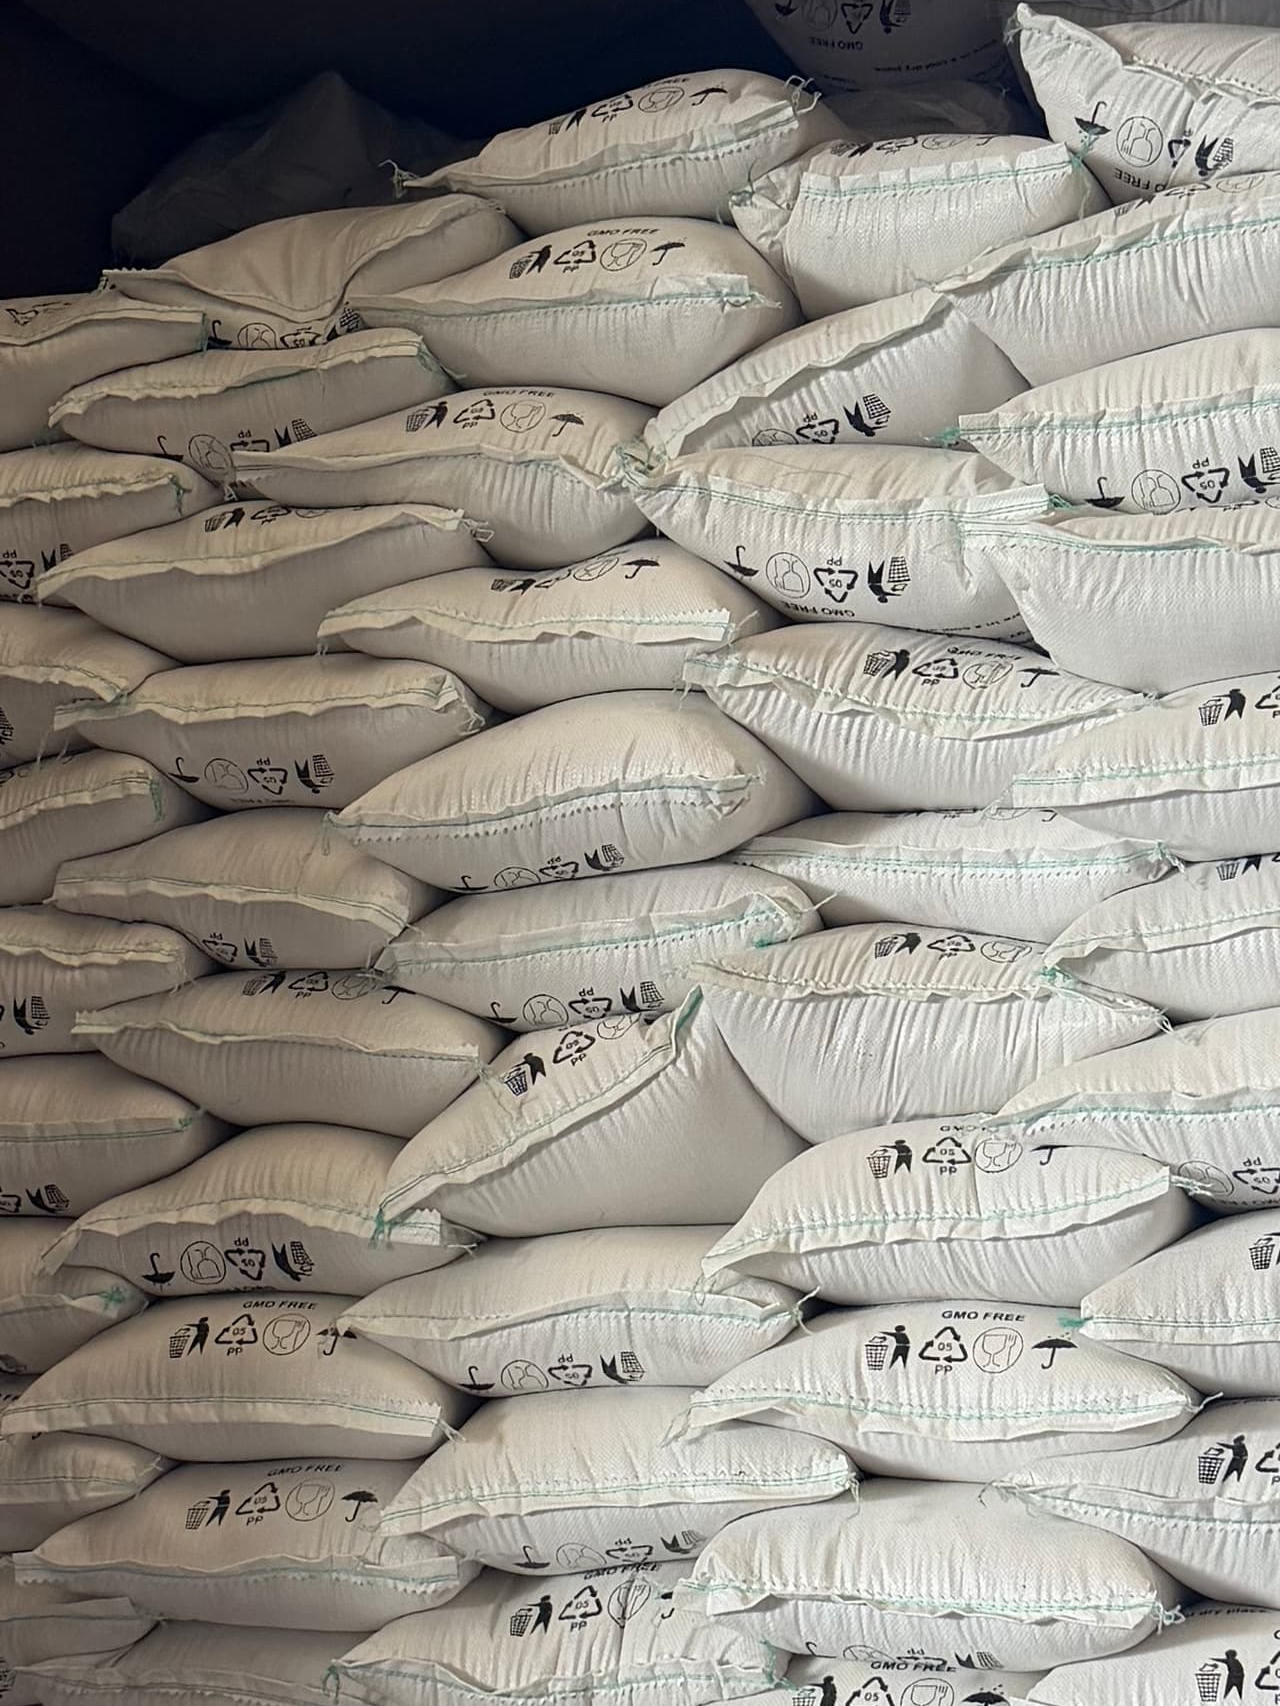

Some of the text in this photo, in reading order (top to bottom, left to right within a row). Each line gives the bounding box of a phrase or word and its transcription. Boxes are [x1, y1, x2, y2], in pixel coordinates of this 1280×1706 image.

[1113, 167, 1151, 190] FREE
[238, 430, 252, 438] PP
[813, 429, 828, 438] 05
[1192, 458, 1209, 468] PP
[2, 550, 17, 558] PP
[827, 558, 842, 566] PP
[10, 570, 24, 578] 05
[829, 579, 842, 588] 05
[256, 757, 271, 766] PP
[295, 990, 313, 998] PP
[579, 987, 595, 997] PP
[570, 1054, 587, 1066] PP
[939, 1148, 956, 1157] 05
[1243, 1157, 1262, 1166] PP
[940, 1164, 957, 1174] PP
[235, 1239, 249, 1248] PP
[241, 1259, 255, 1267] 05
[243, 1300, 318, 1310] GMO FREE
[941, 1310, 1025, 1322] GMO FREE
[232, 1327, 247, 1336] 05
[226, 1347, 243, 1356] PP
[937, 1343, 952, 1351] 05
[558, 1354, 574, 1363] PP
[935, 1365, 953, 1374] PP
[268, 1467, 302, 1477] GMO
[246, 1515, 263, 1525] PP
[574, 1600, 590, 1609] 05
[570, 1620, 588, 1630] PP
[871, 1660, 908, 1671] GMO
[864, 1692, 879, 1701] 05
